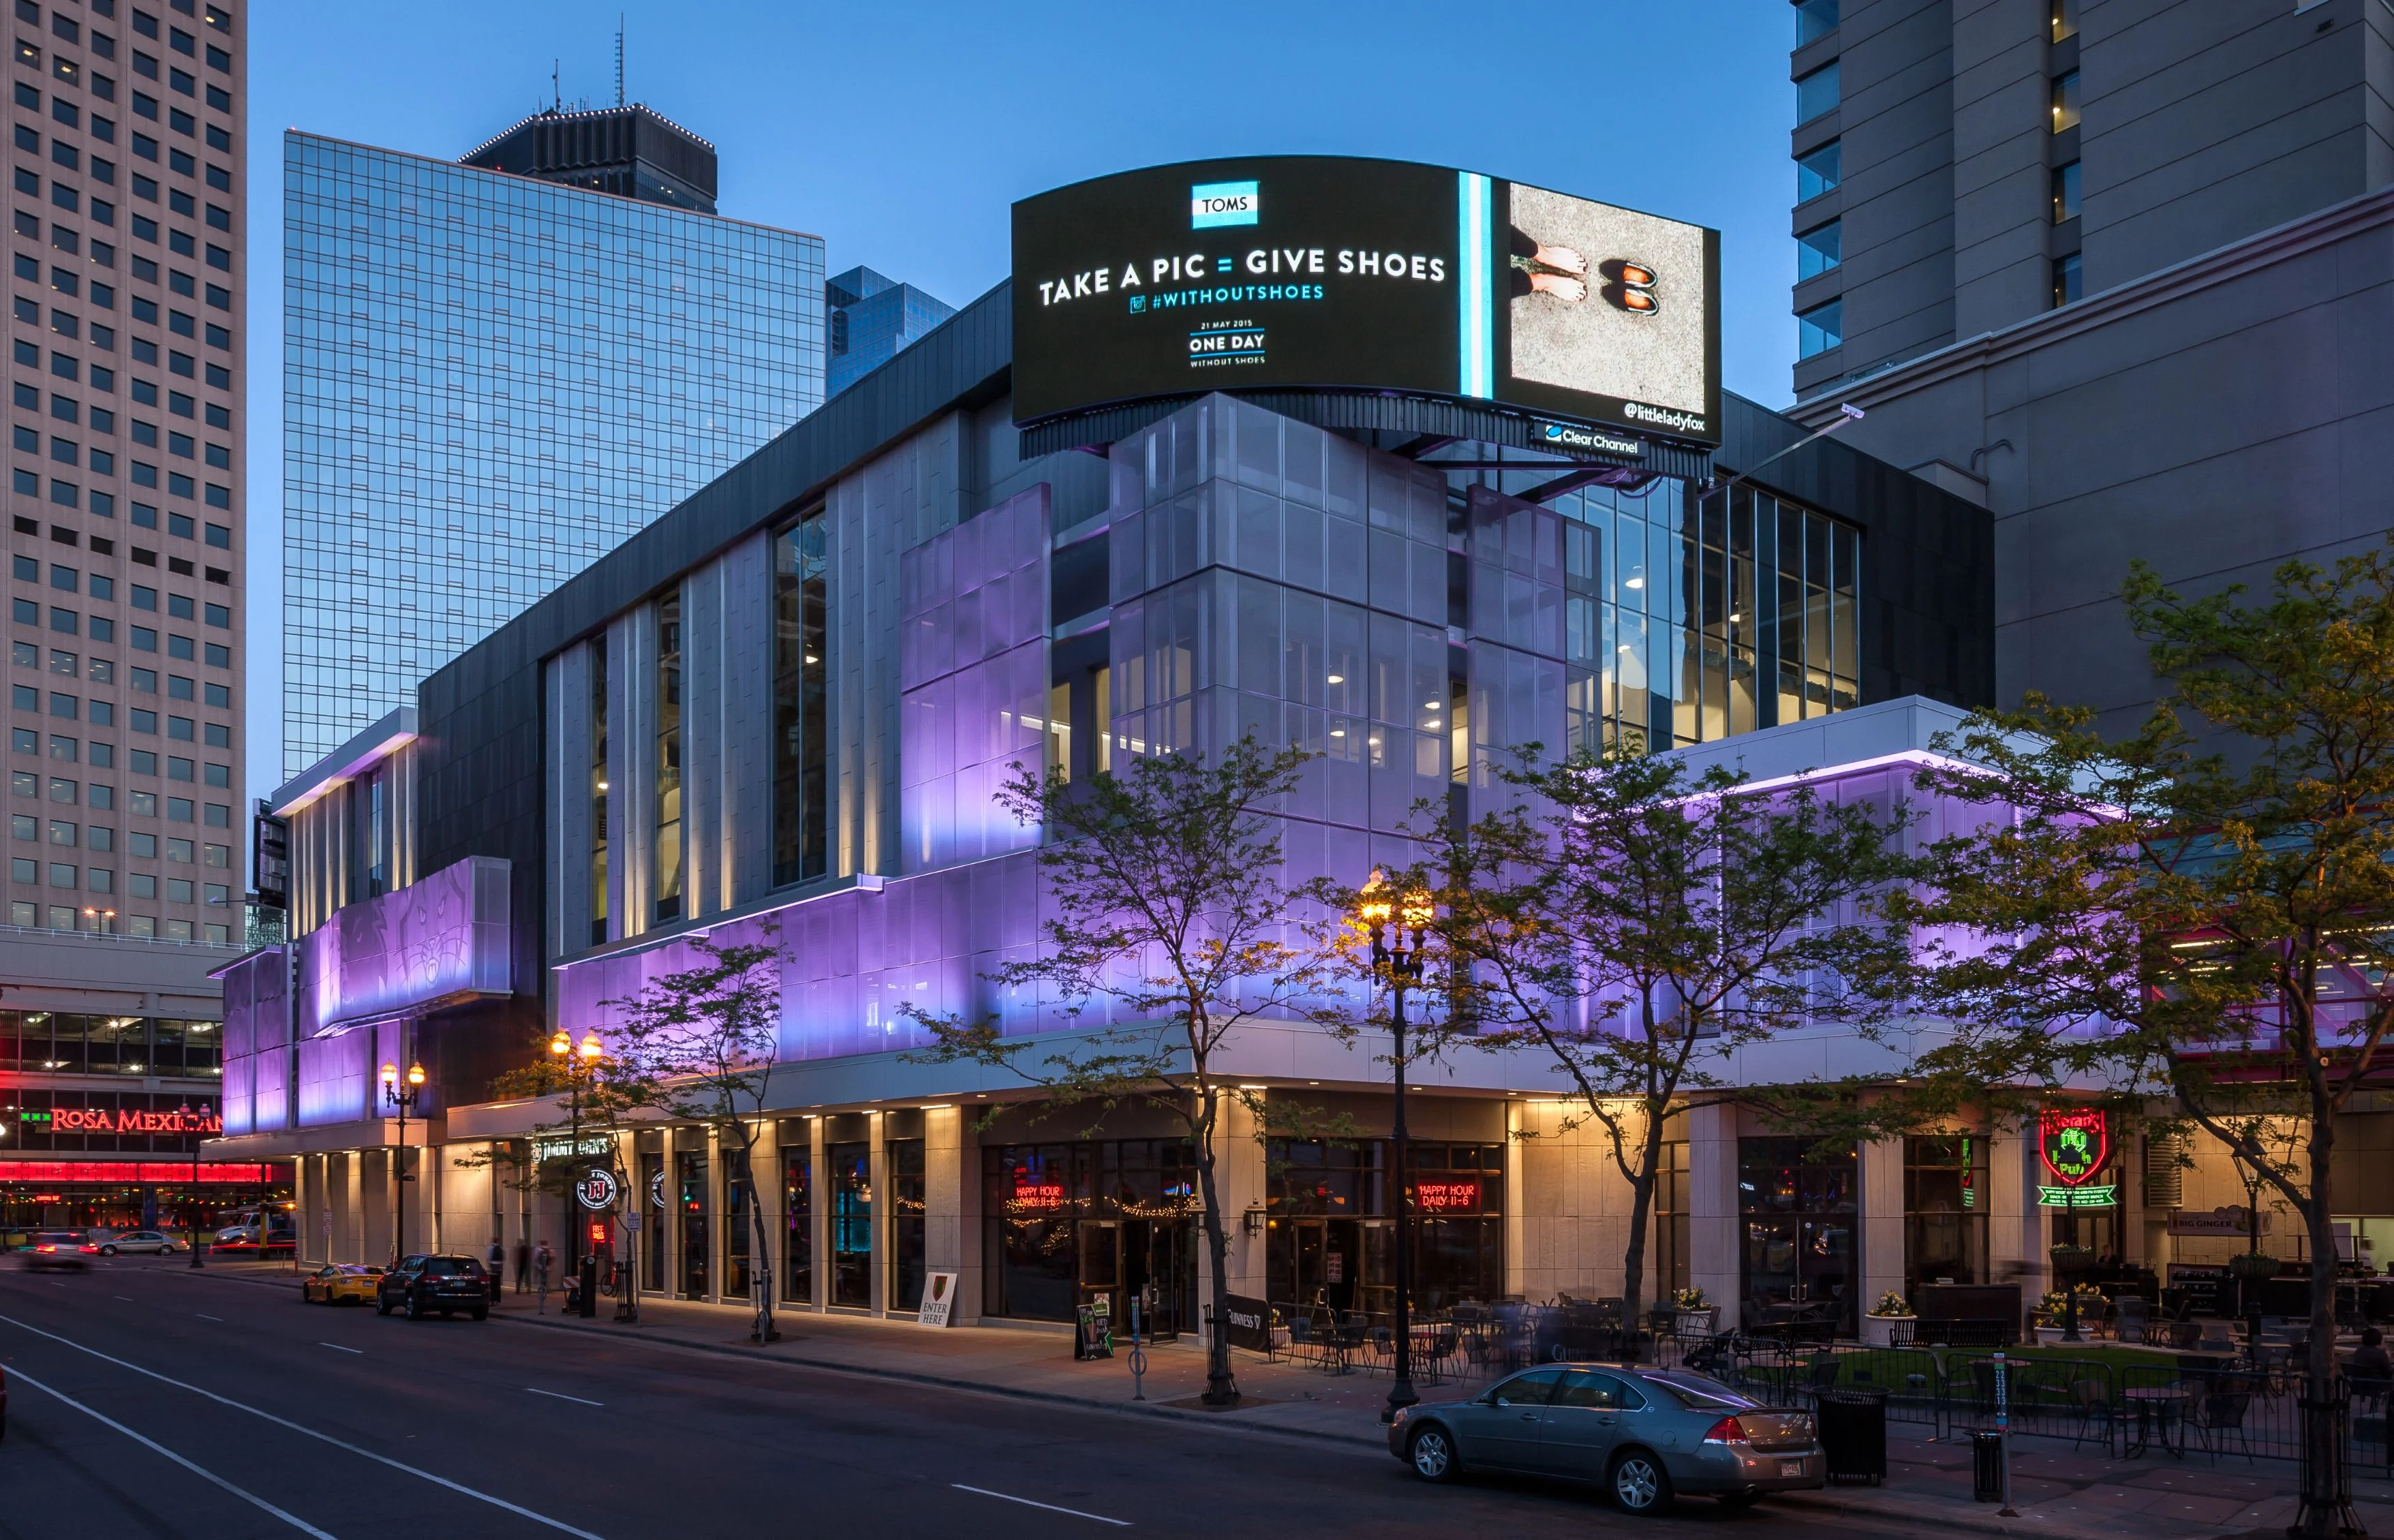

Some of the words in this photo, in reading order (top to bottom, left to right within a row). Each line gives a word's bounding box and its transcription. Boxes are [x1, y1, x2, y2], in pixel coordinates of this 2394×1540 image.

[1201, 196, 1248, 213] TOMS
[1039, 267, 1109, 307] TAKE
[1120, 262, 1141, 289] A
[1152, 253, 1205, 283] PIC
[1246, 249, 1325, 275] GIVE
[1338, 249, 1445, 281] SHOES
[1152, 284, 1323, 309] #WITHOUTSHOES
[1233, 319, 1253, 328] 2015
[1190, 336, 1225, 352] ONE
[1231, 334, 1264, 349] DAY
[1191, 358, 1231, 368] WITHOUT
[1235, 356, 1265, 365] SHOES
[1624, 403, 1705, 431] @littleladyfox
[1563, 429, 1592, 446] Clear
[1593, 435, 1638, 454] Channel
[52, 1109, 113, 1130] ROSA
[2059, 1163, 2084, 1175] Pub
[1017, 1186, 1037, 1197] HAPPY
[1040, 1186, 1060, 1197] HOUR
[1419, 1185, 1447, 1195] HAPPY
[1450, 1185, 1475, 1195] HOUR
[1019, 1197, 1039, 1207] DAILY
[1422, 1196, 1447, 1206] DAILY
[593, 1225, 604, 1233] FREE
[2179, 1220, 2194, 1228] BIG
[2196, 1220, 2232, 1228] GINGER
[923, 1302, 947, 1314] ENTER
[923, 1314, 943, 1325] HERE
